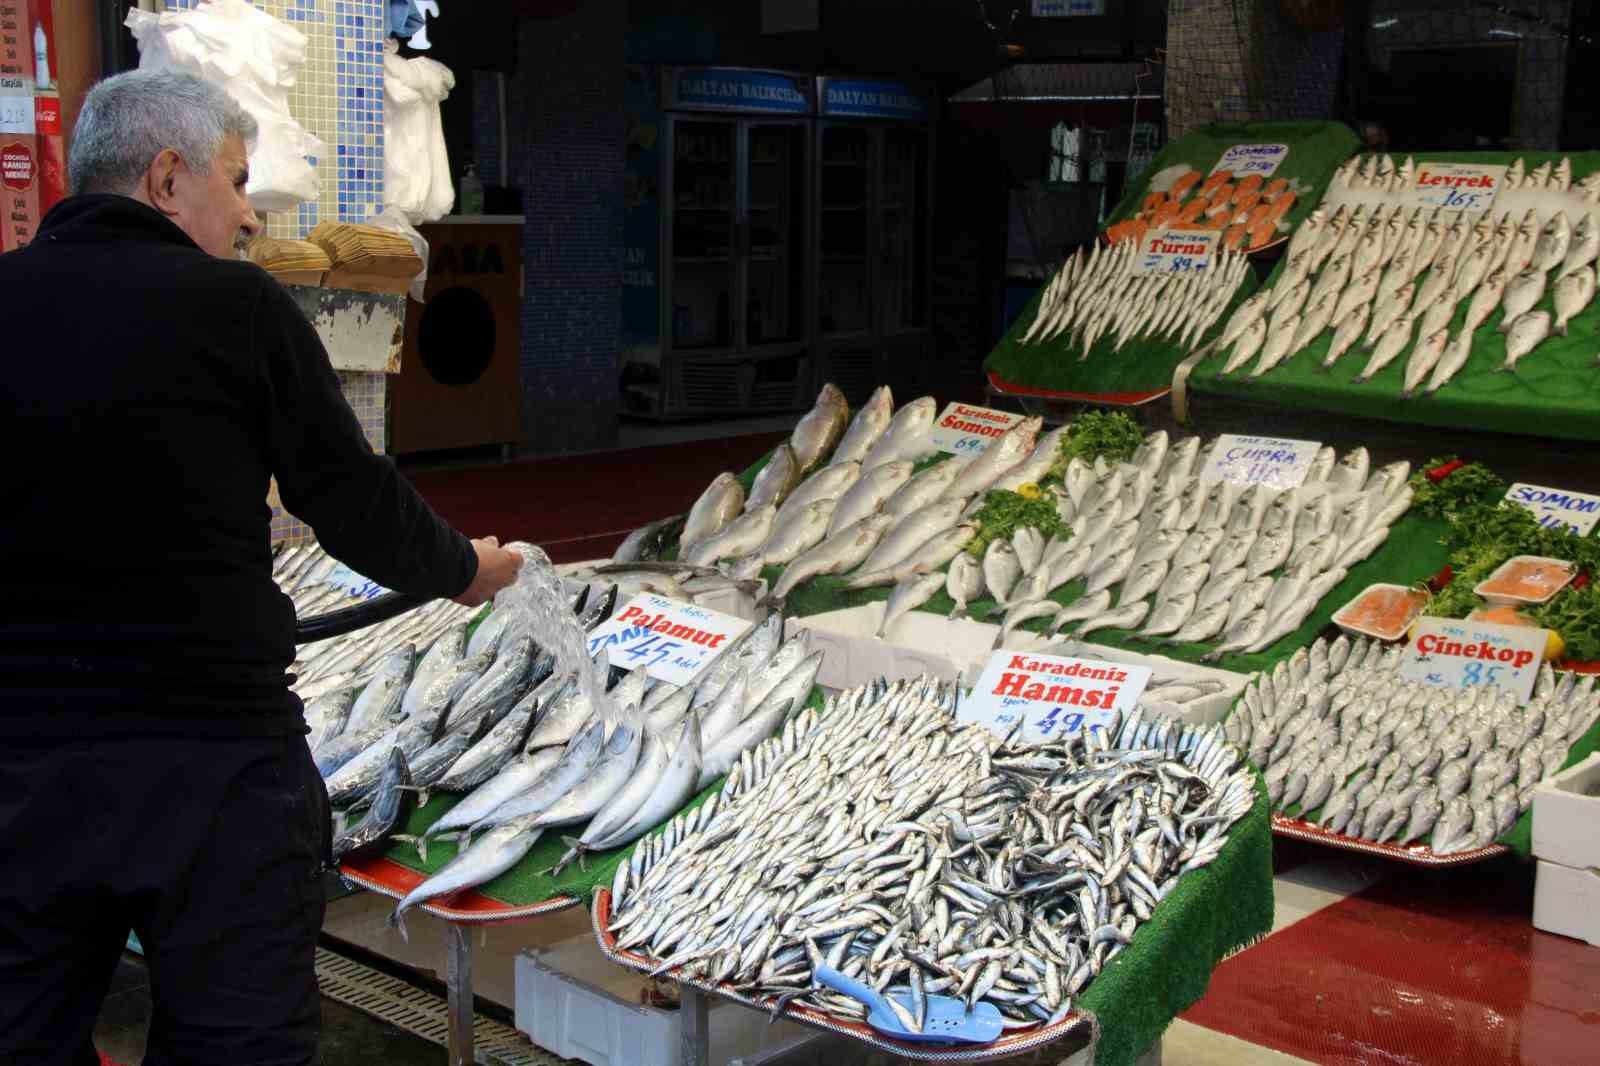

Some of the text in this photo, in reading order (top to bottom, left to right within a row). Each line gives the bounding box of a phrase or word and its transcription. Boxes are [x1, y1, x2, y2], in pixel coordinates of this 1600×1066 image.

[680, 79, 737, 97] DALYAN
[827, 88, 877, 105] DALYAN
[1417, 171, 1496, 188] Levrek
[1149, 239, 1206, 255] Turna
[953, 405, 1011, 424] Karadeniz
[940, 414, 1005, 437] Somon
[1225, 447, 1297, 465] ÇUPRA
[1510, 486, 1600, 513] SOMON
[616, 605, 728, 649] Palamut
[1416, 633, 1535, 668] Çinekop
[1007, 654, 1128, 683] Karadeniz
[991, 671, 1121, 710] Hamsi
